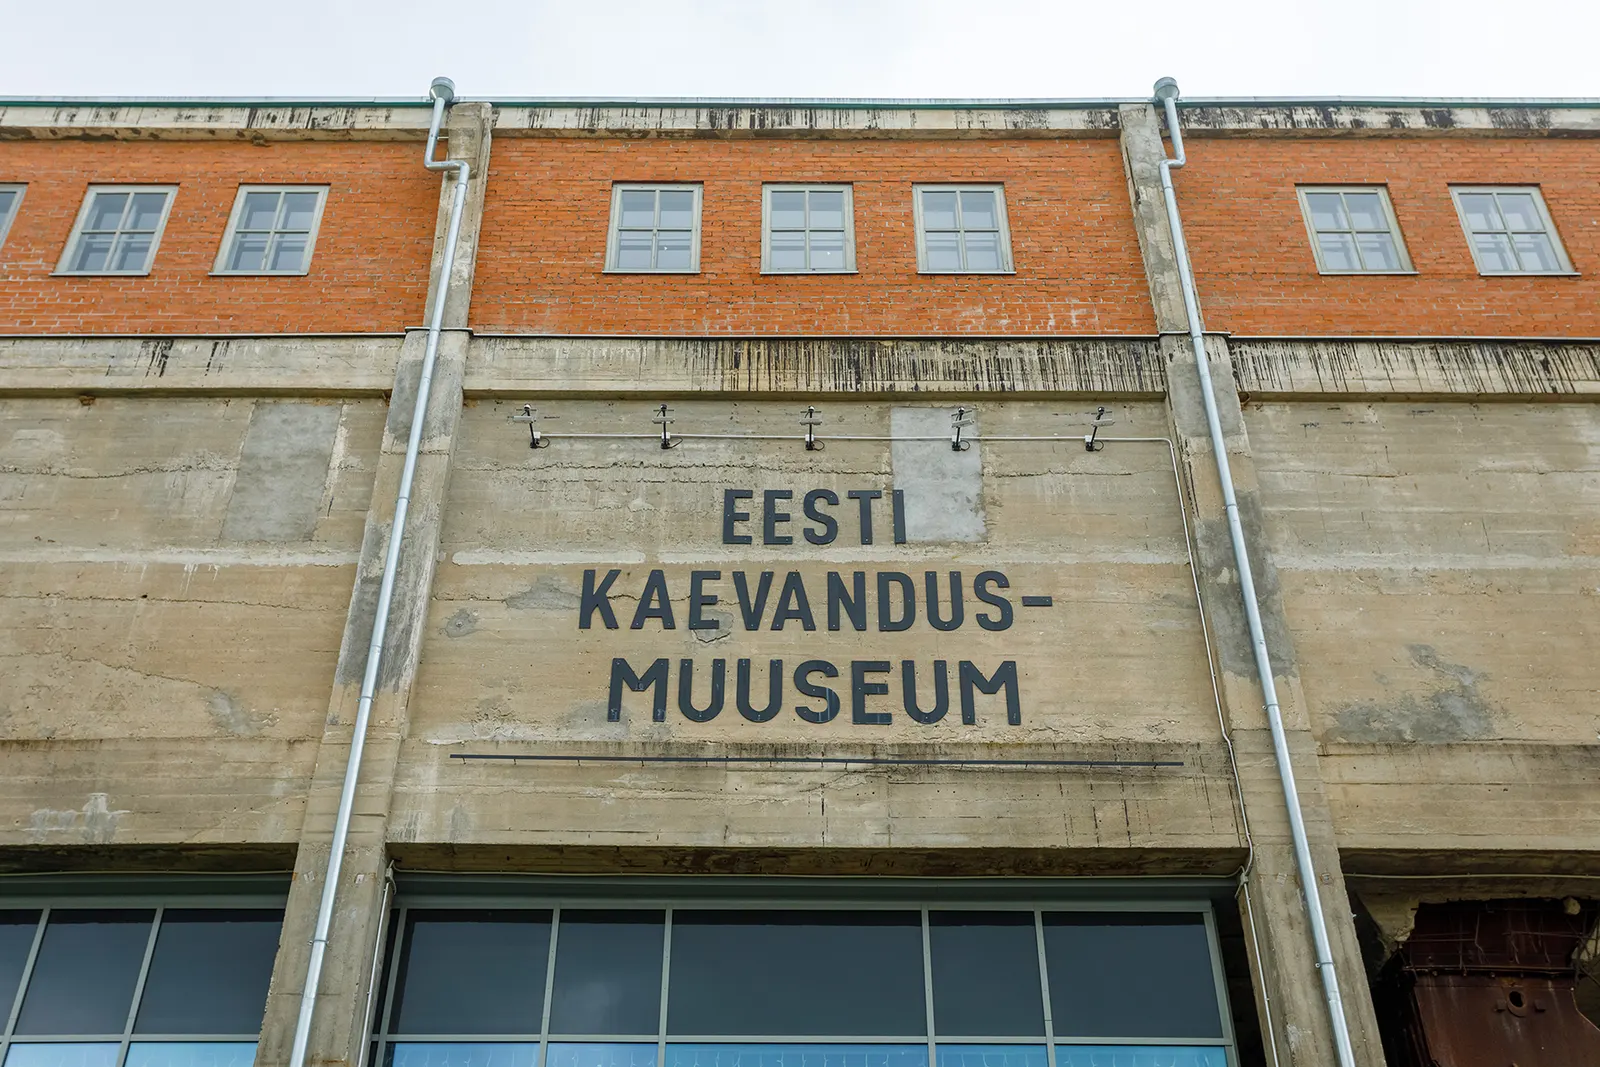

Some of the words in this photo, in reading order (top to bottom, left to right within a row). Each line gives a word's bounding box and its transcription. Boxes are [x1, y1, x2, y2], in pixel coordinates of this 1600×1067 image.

[723, 488, 906, 546] EESTI
[578, 569, 1052, 632] KAEVANDUS-
[607, 657, 1022, 726] MUUSEUM
